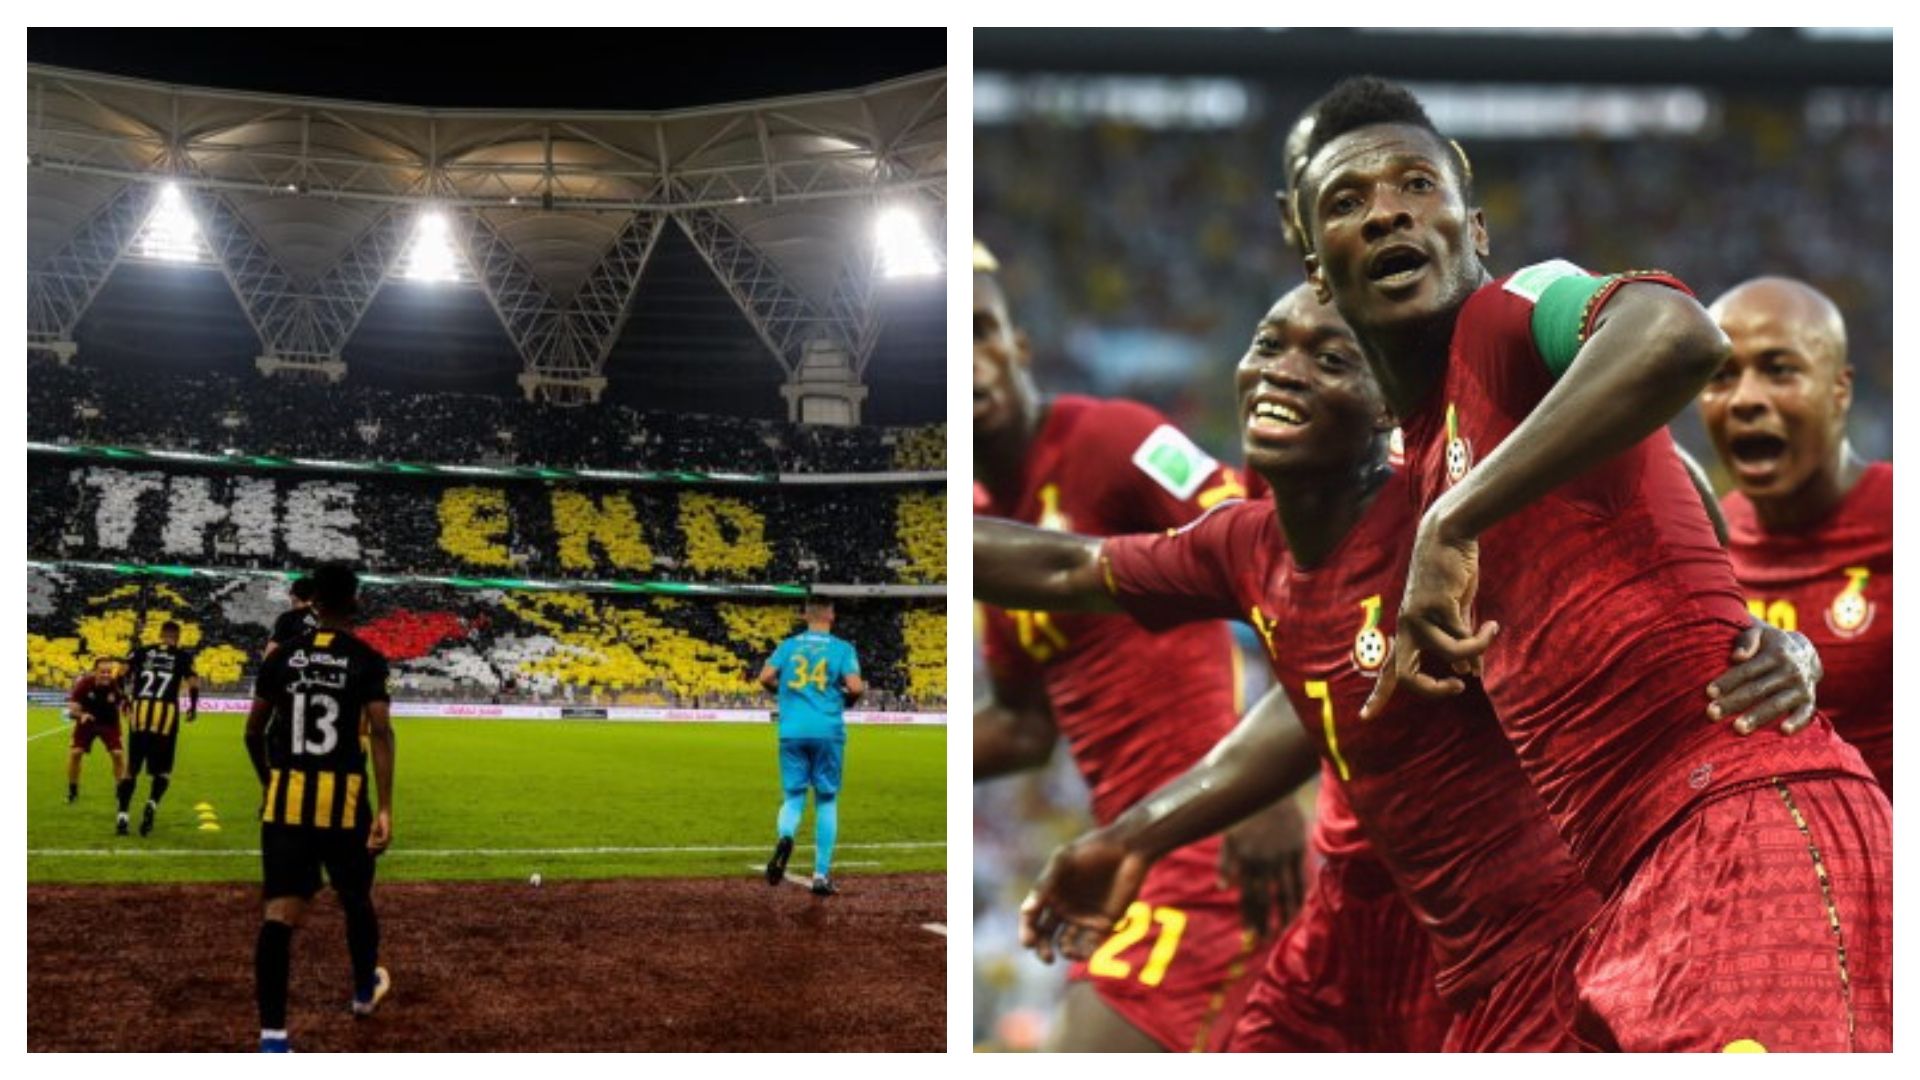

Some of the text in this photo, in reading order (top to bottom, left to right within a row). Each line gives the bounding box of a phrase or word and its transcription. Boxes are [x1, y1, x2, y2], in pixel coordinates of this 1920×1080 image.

[84, 465, 361, 560] THE
[139, 670, 173, 698] 27
[788, 654, 827, 692] 34
[291, 693, 339, 755] 13
[1305, 681, 1350, 781] 7
[1088, 901, 1187, 986] 21
